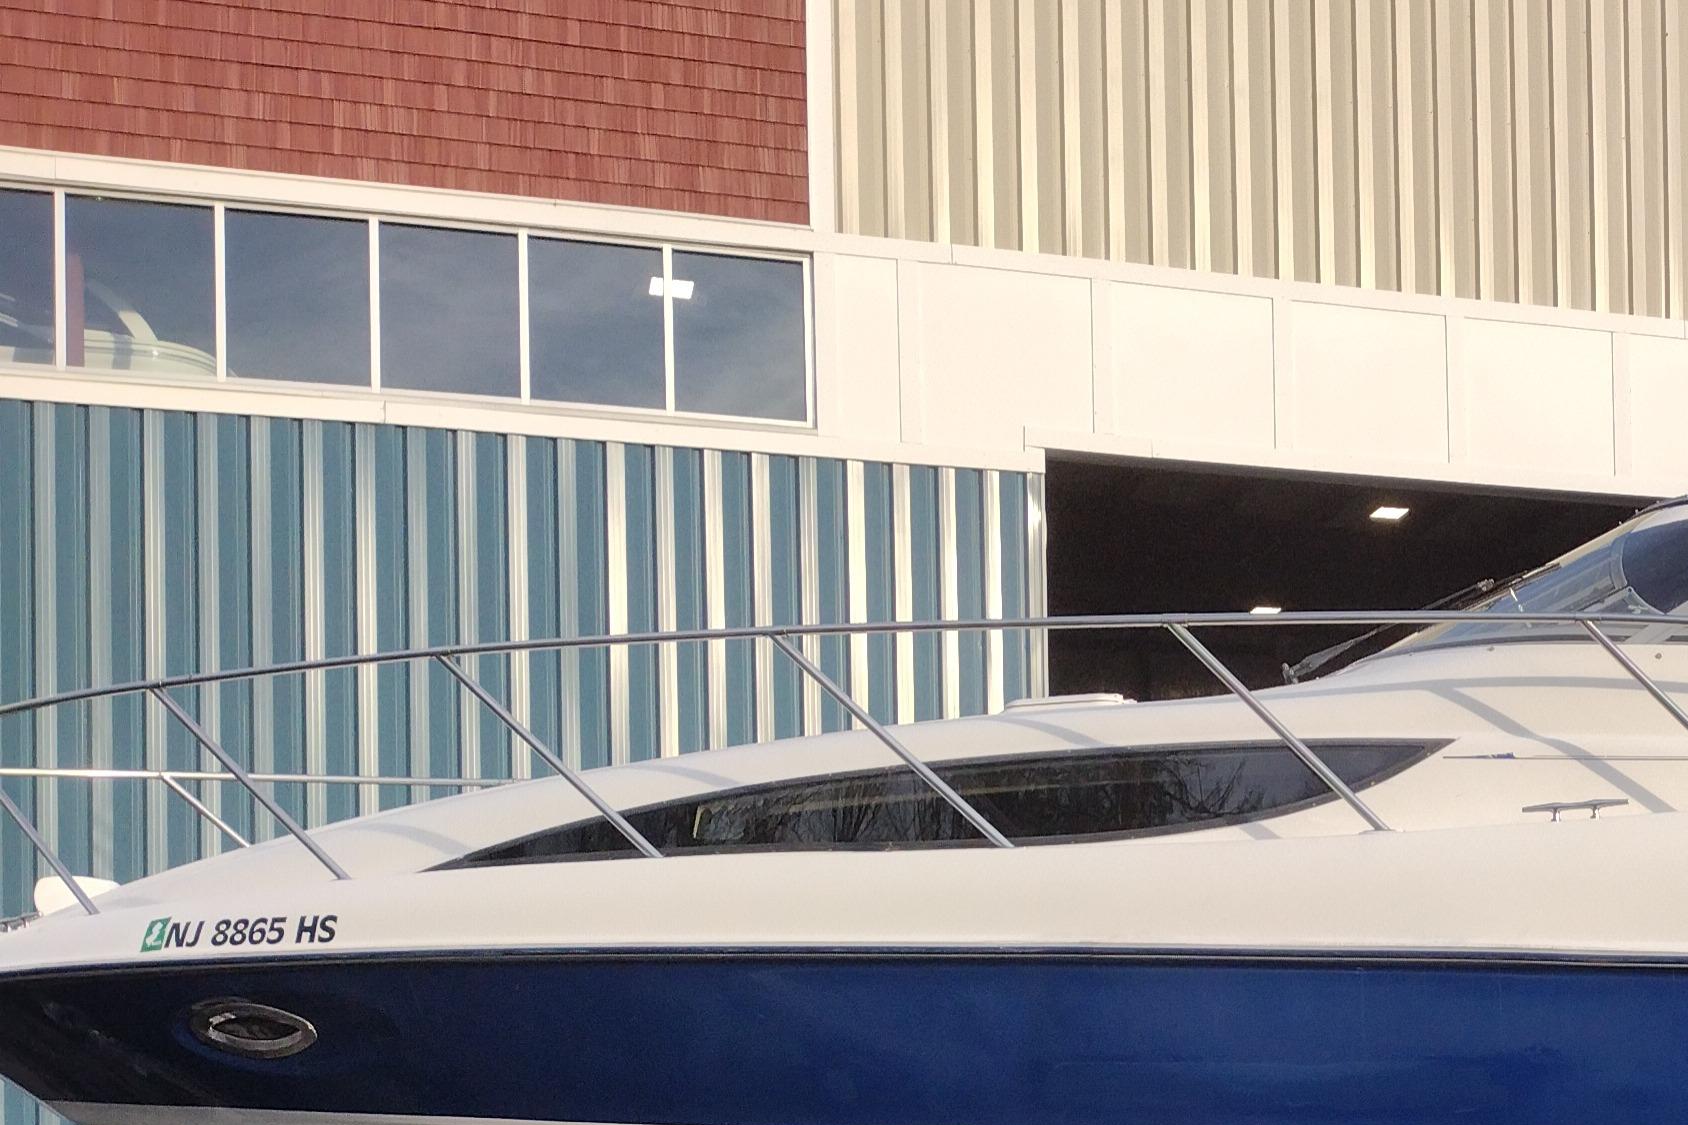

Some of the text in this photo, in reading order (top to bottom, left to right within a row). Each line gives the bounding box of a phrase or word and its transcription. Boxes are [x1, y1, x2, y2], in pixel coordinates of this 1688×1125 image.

[164, 914, 338, 948] NJ 8865 HS
